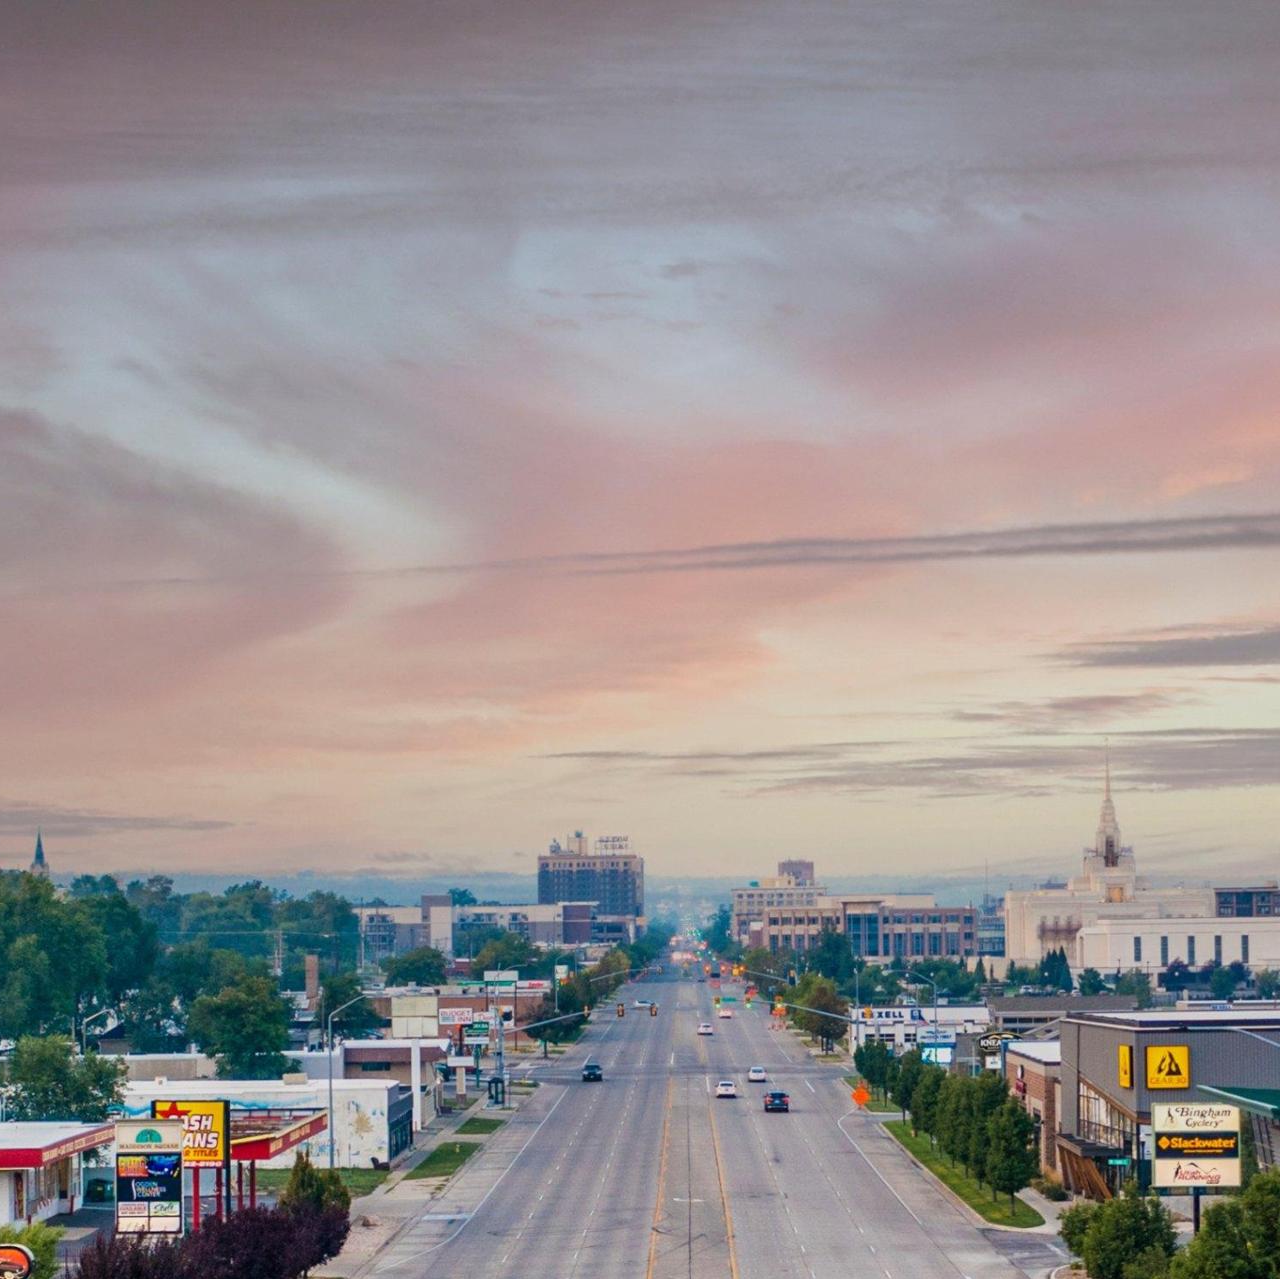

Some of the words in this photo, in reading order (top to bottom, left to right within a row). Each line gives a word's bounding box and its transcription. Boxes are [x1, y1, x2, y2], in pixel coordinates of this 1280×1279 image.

[1175, 1107, 1231, 1119] Bingham
[1185, 1118, 1220, 1128] Cyclery
[1170, 1136, 1234, 1148] Slackwater
